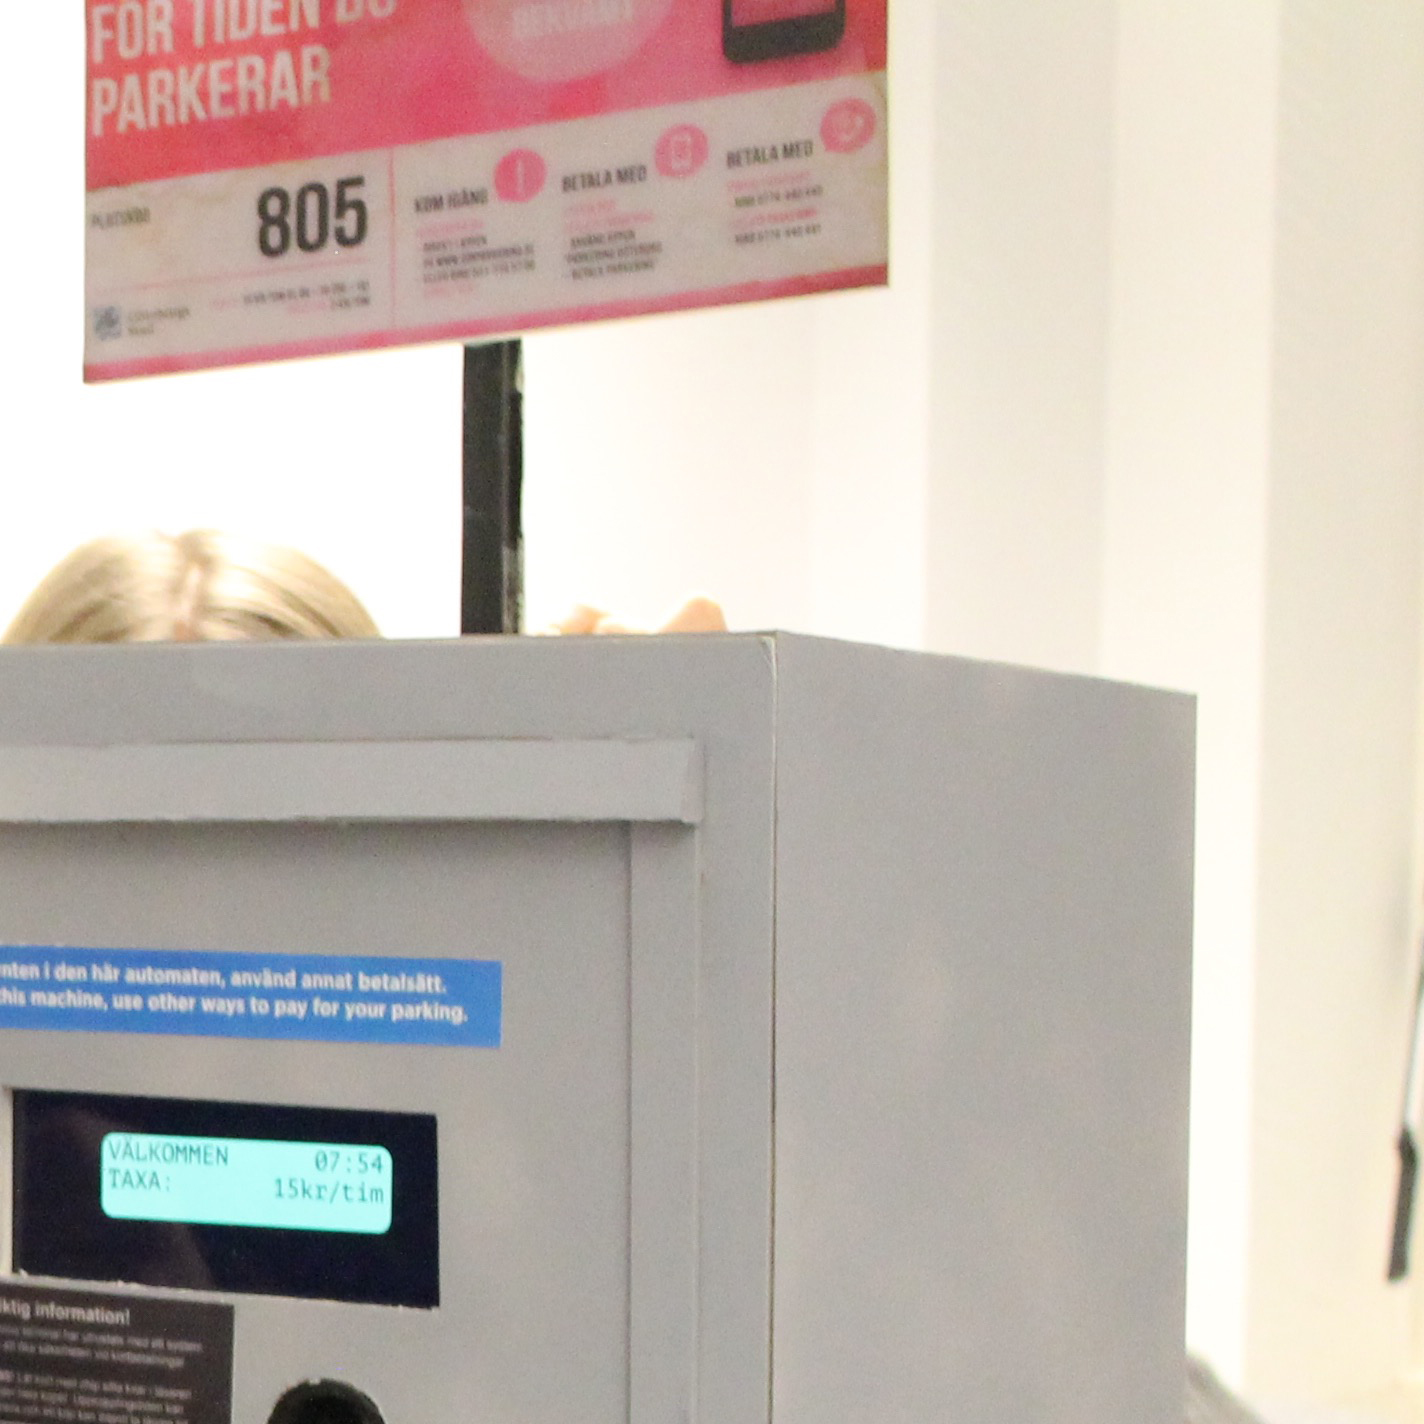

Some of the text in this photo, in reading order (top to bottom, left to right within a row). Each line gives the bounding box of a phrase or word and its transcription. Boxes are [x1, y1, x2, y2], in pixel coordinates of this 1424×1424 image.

[92, 44, 333, 137] PARKERAR
[257, 176, 368, 258] 805
[44, 961, 50, 980] i
[54, 961, 87, 981] den
[91, 962, 120, 982] här
[125, 966, 226, 989] automaten,
[230, 967, 297, 988] använd
[302, 972, 353, 991] annat
[358, 971, 447, 994] betalsätt.
[30, 989, 109, 1011] machine,
[112, 995, 143, 1010] use
[147, 993, 197, 1012] other
[202, 997, 246, 1016] ways
[251, 996, 270, 1013] to
[274, 999, 308, 1019] pay
[313, 997, 340, 1017] for
[345, 1002, 386, 1020] your
[391, 1001, 469, 1025] parking.
[108, 1136, 383, 1174] VÄLKOMMEN 07:54
[109, 1169, 384, 1204] TAXA: 15kr/tim
[35, 1301, 130, 1326] information!
